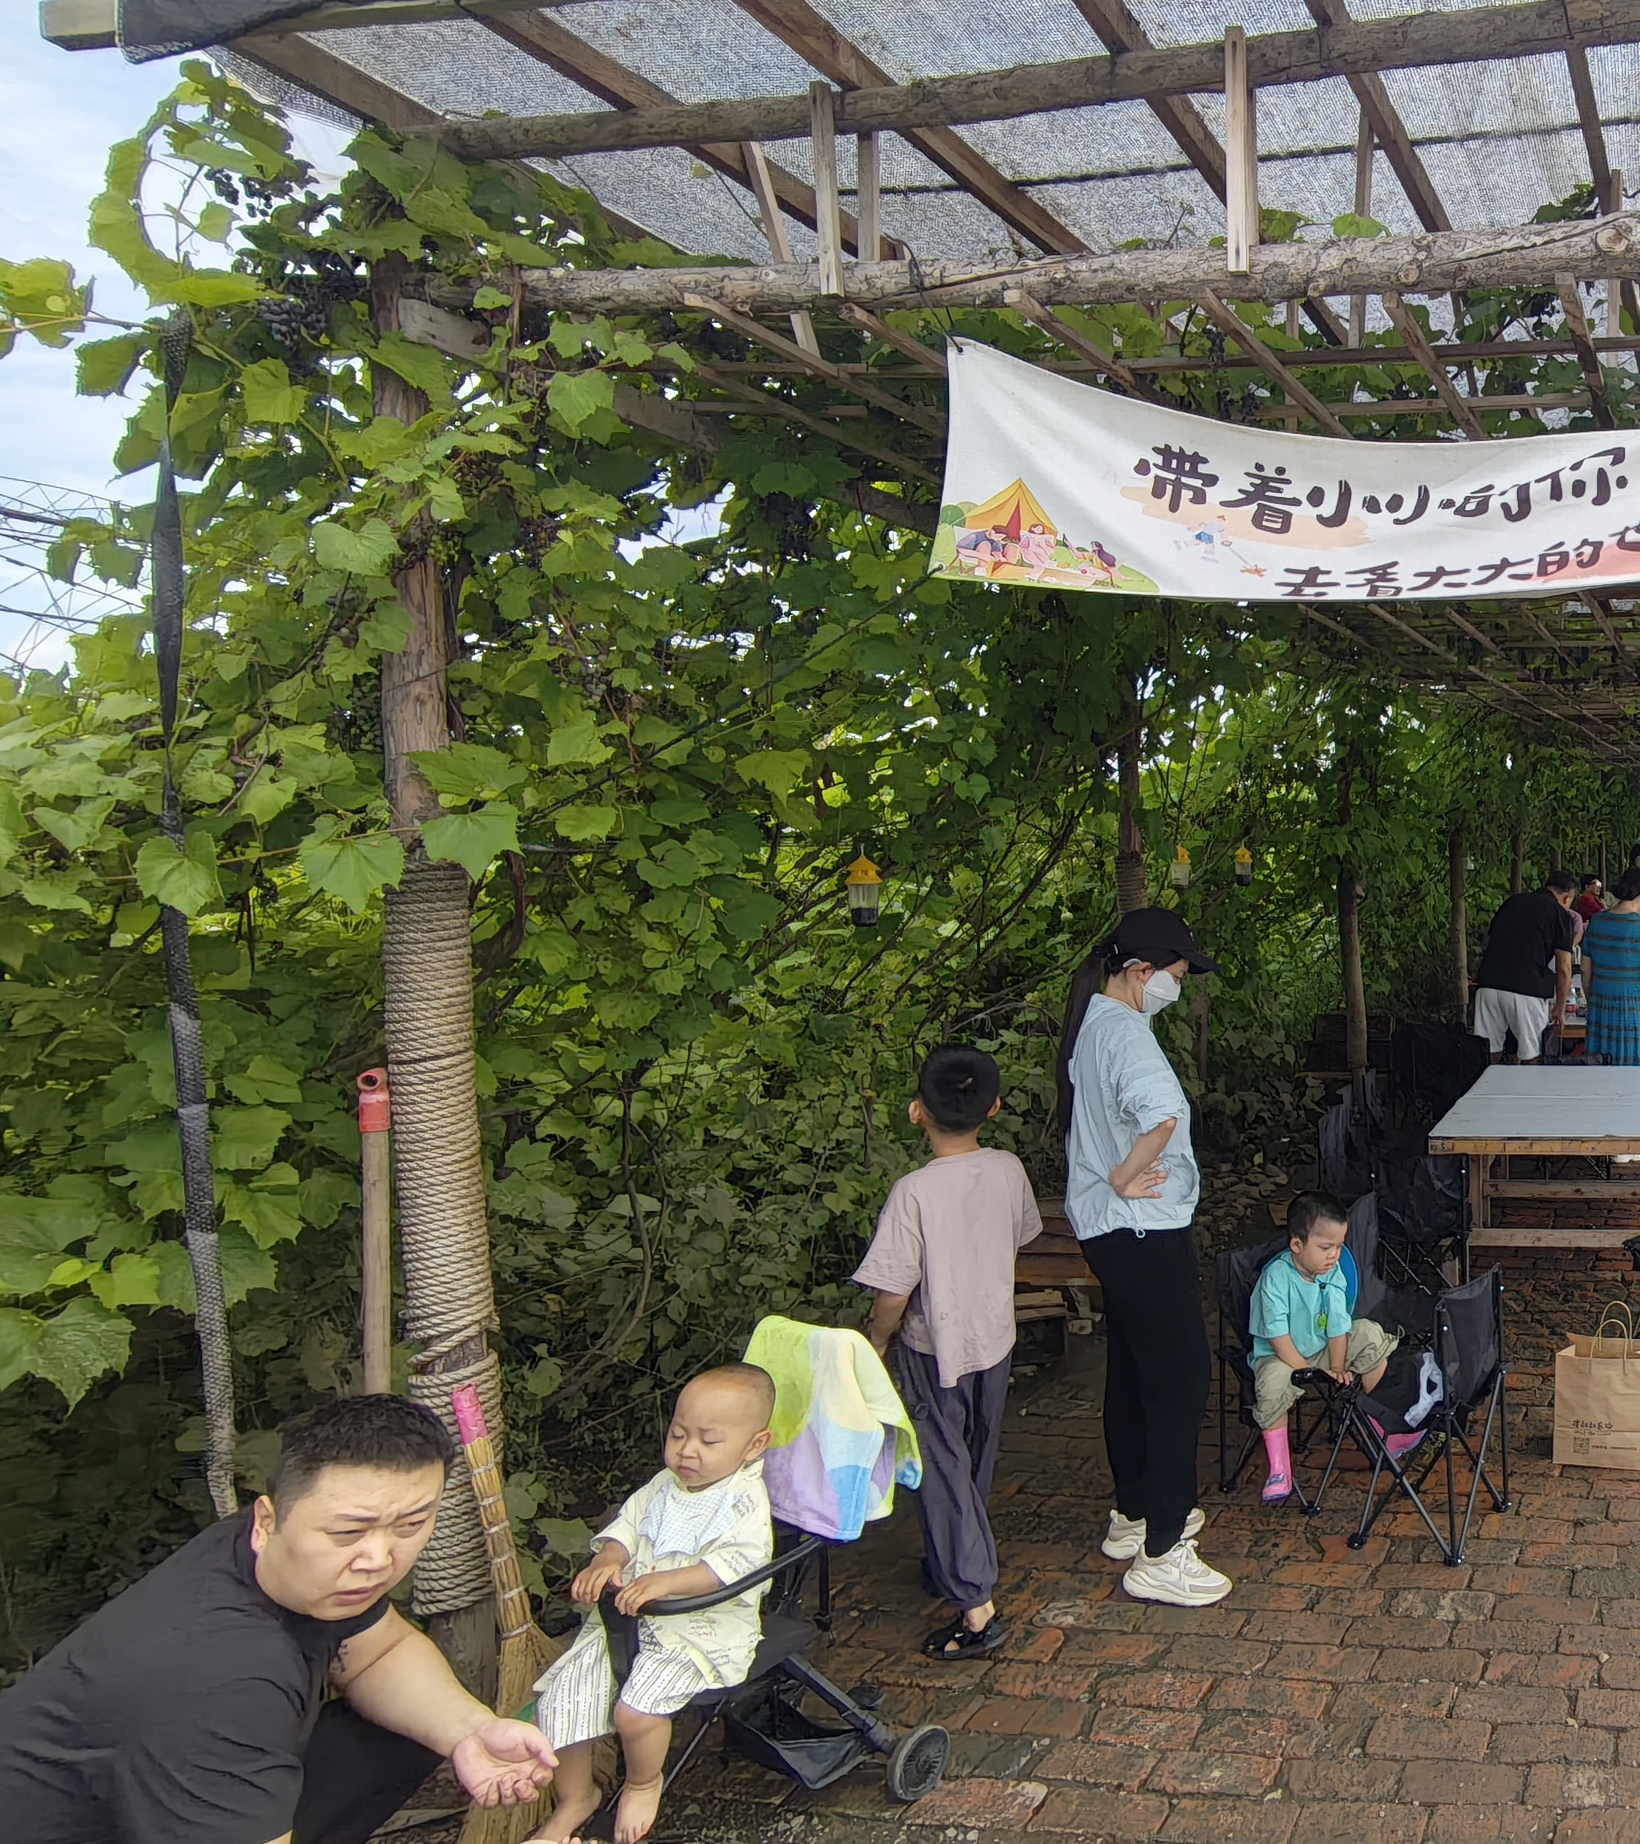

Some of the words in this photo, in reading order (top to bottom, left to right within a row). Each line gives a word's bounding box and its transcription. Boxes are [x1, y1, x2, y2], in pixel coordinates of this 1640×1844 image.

[1133, 443, 1628, 534] 带着小小的你
